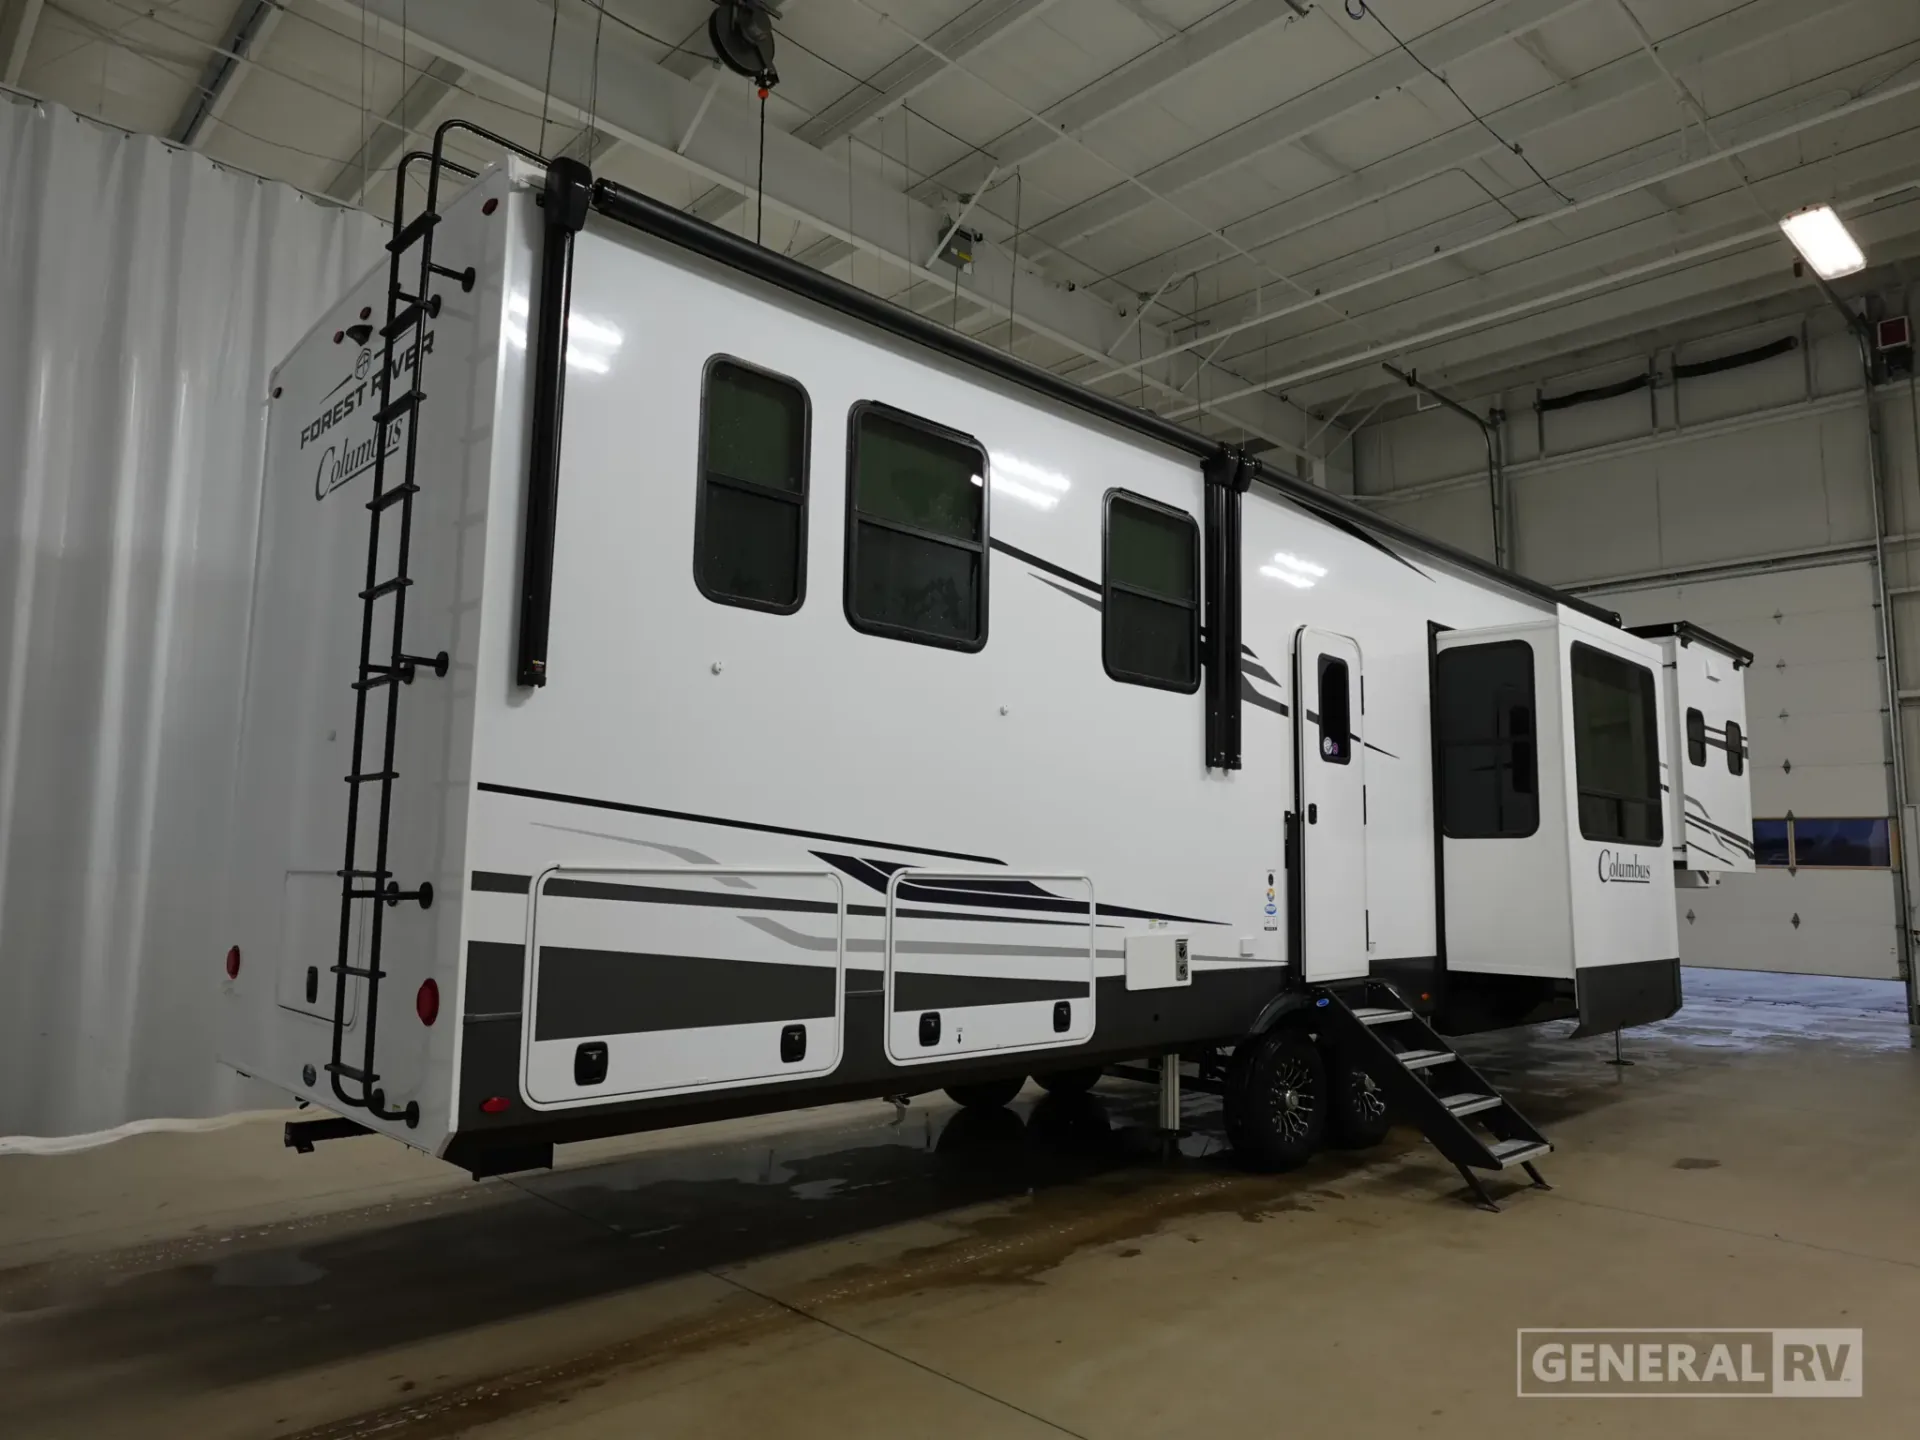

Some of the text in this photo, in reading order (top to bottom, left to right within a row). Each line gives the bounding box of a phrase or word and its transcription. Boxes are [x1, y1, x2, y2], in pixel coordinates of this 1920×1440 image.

[300, 330, 434, 450] FOREST RVER
[1598, 848, 1650, 883] Columbus
